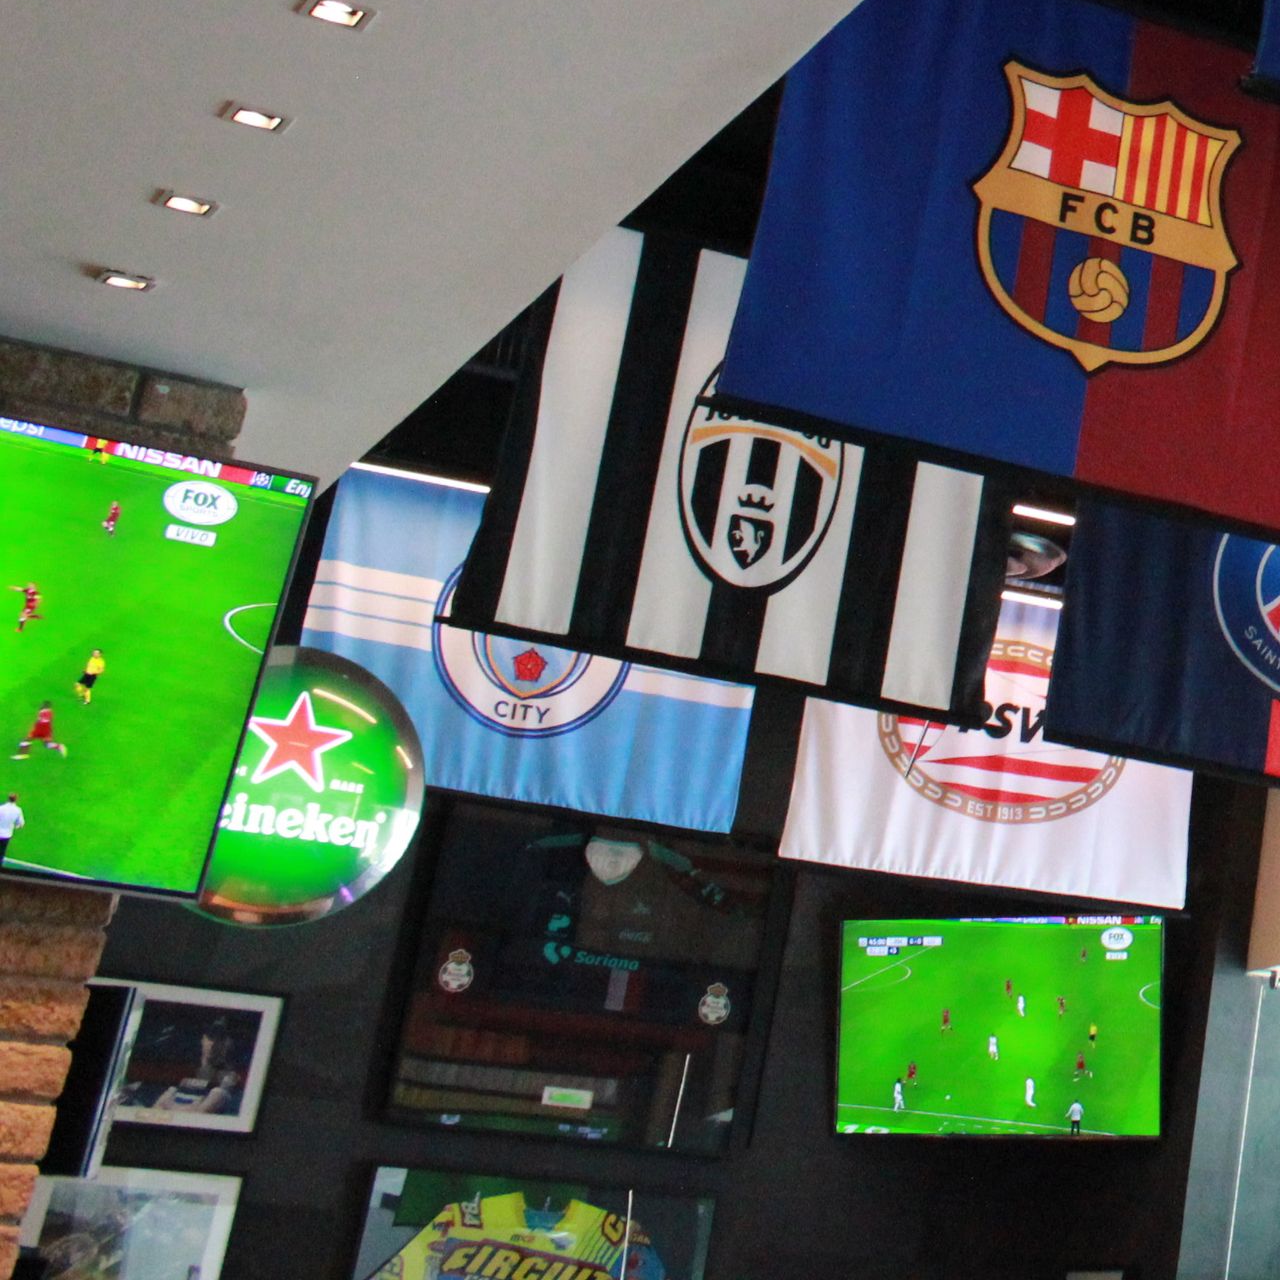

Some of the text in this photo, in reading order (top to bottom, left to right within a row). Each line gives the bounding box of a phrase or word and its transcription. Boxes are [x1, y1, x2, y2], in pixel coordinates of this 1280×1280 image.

[116, 442, 223, 478] NISSAN
[181, 488, 222, 511] FOX
[175, 527, 209, 544] VIVO
[494, 700, 550, 724] CITY
[966, 799, 1023, 820] EST 1913
[219, 792, 380, 857] eineken
[1076, 915, 1122, 925] NISSAN
[1108, 931, 1125, 941] FOX
[574, 950, 640, 971] Soriana
